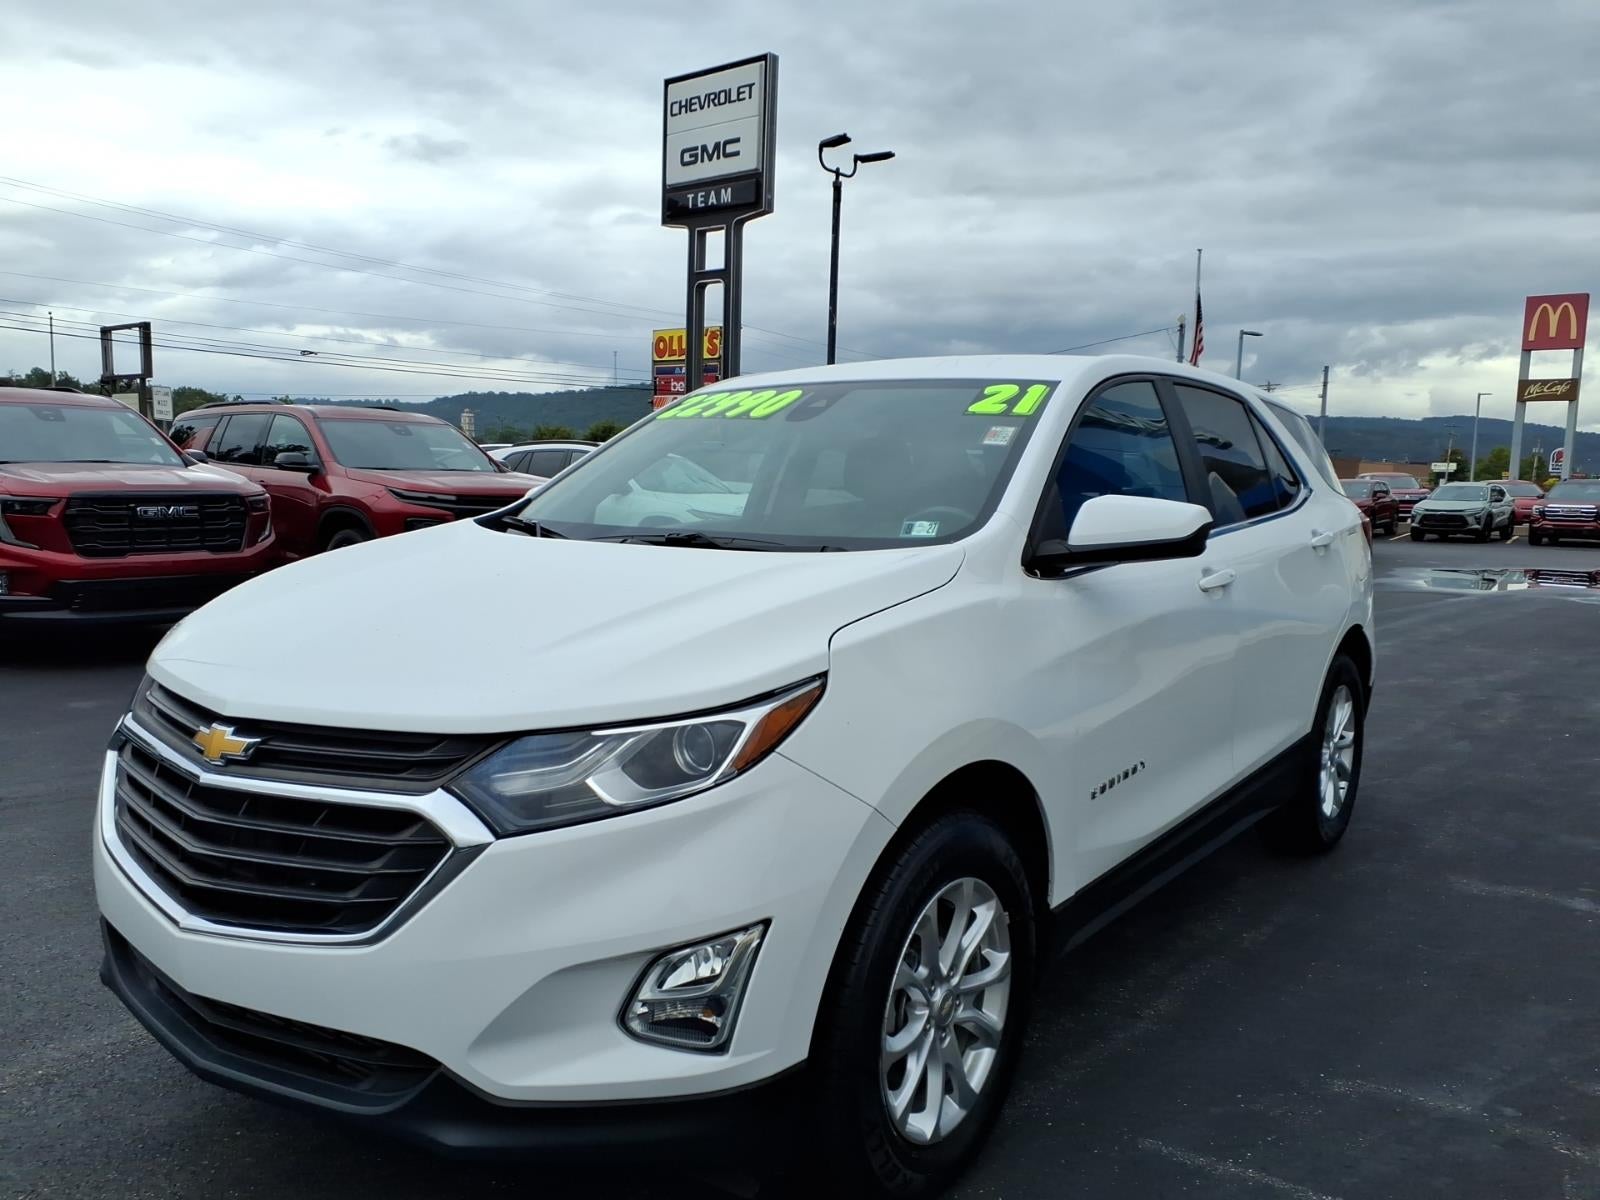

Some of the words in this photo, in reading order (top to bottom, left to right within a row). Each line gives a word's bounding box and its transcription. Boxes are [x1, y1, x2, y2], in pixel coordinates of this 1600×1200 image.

[670, 82, 755, 117] CHEVROLET
[680, 137, 741, 166] GMC
[687, 188, 732, 209] TEAM
[655, 329, 720, 358] OLL'S
[967, 384, 1050, 415] 21
[136, 506, 199, 519] GMC
